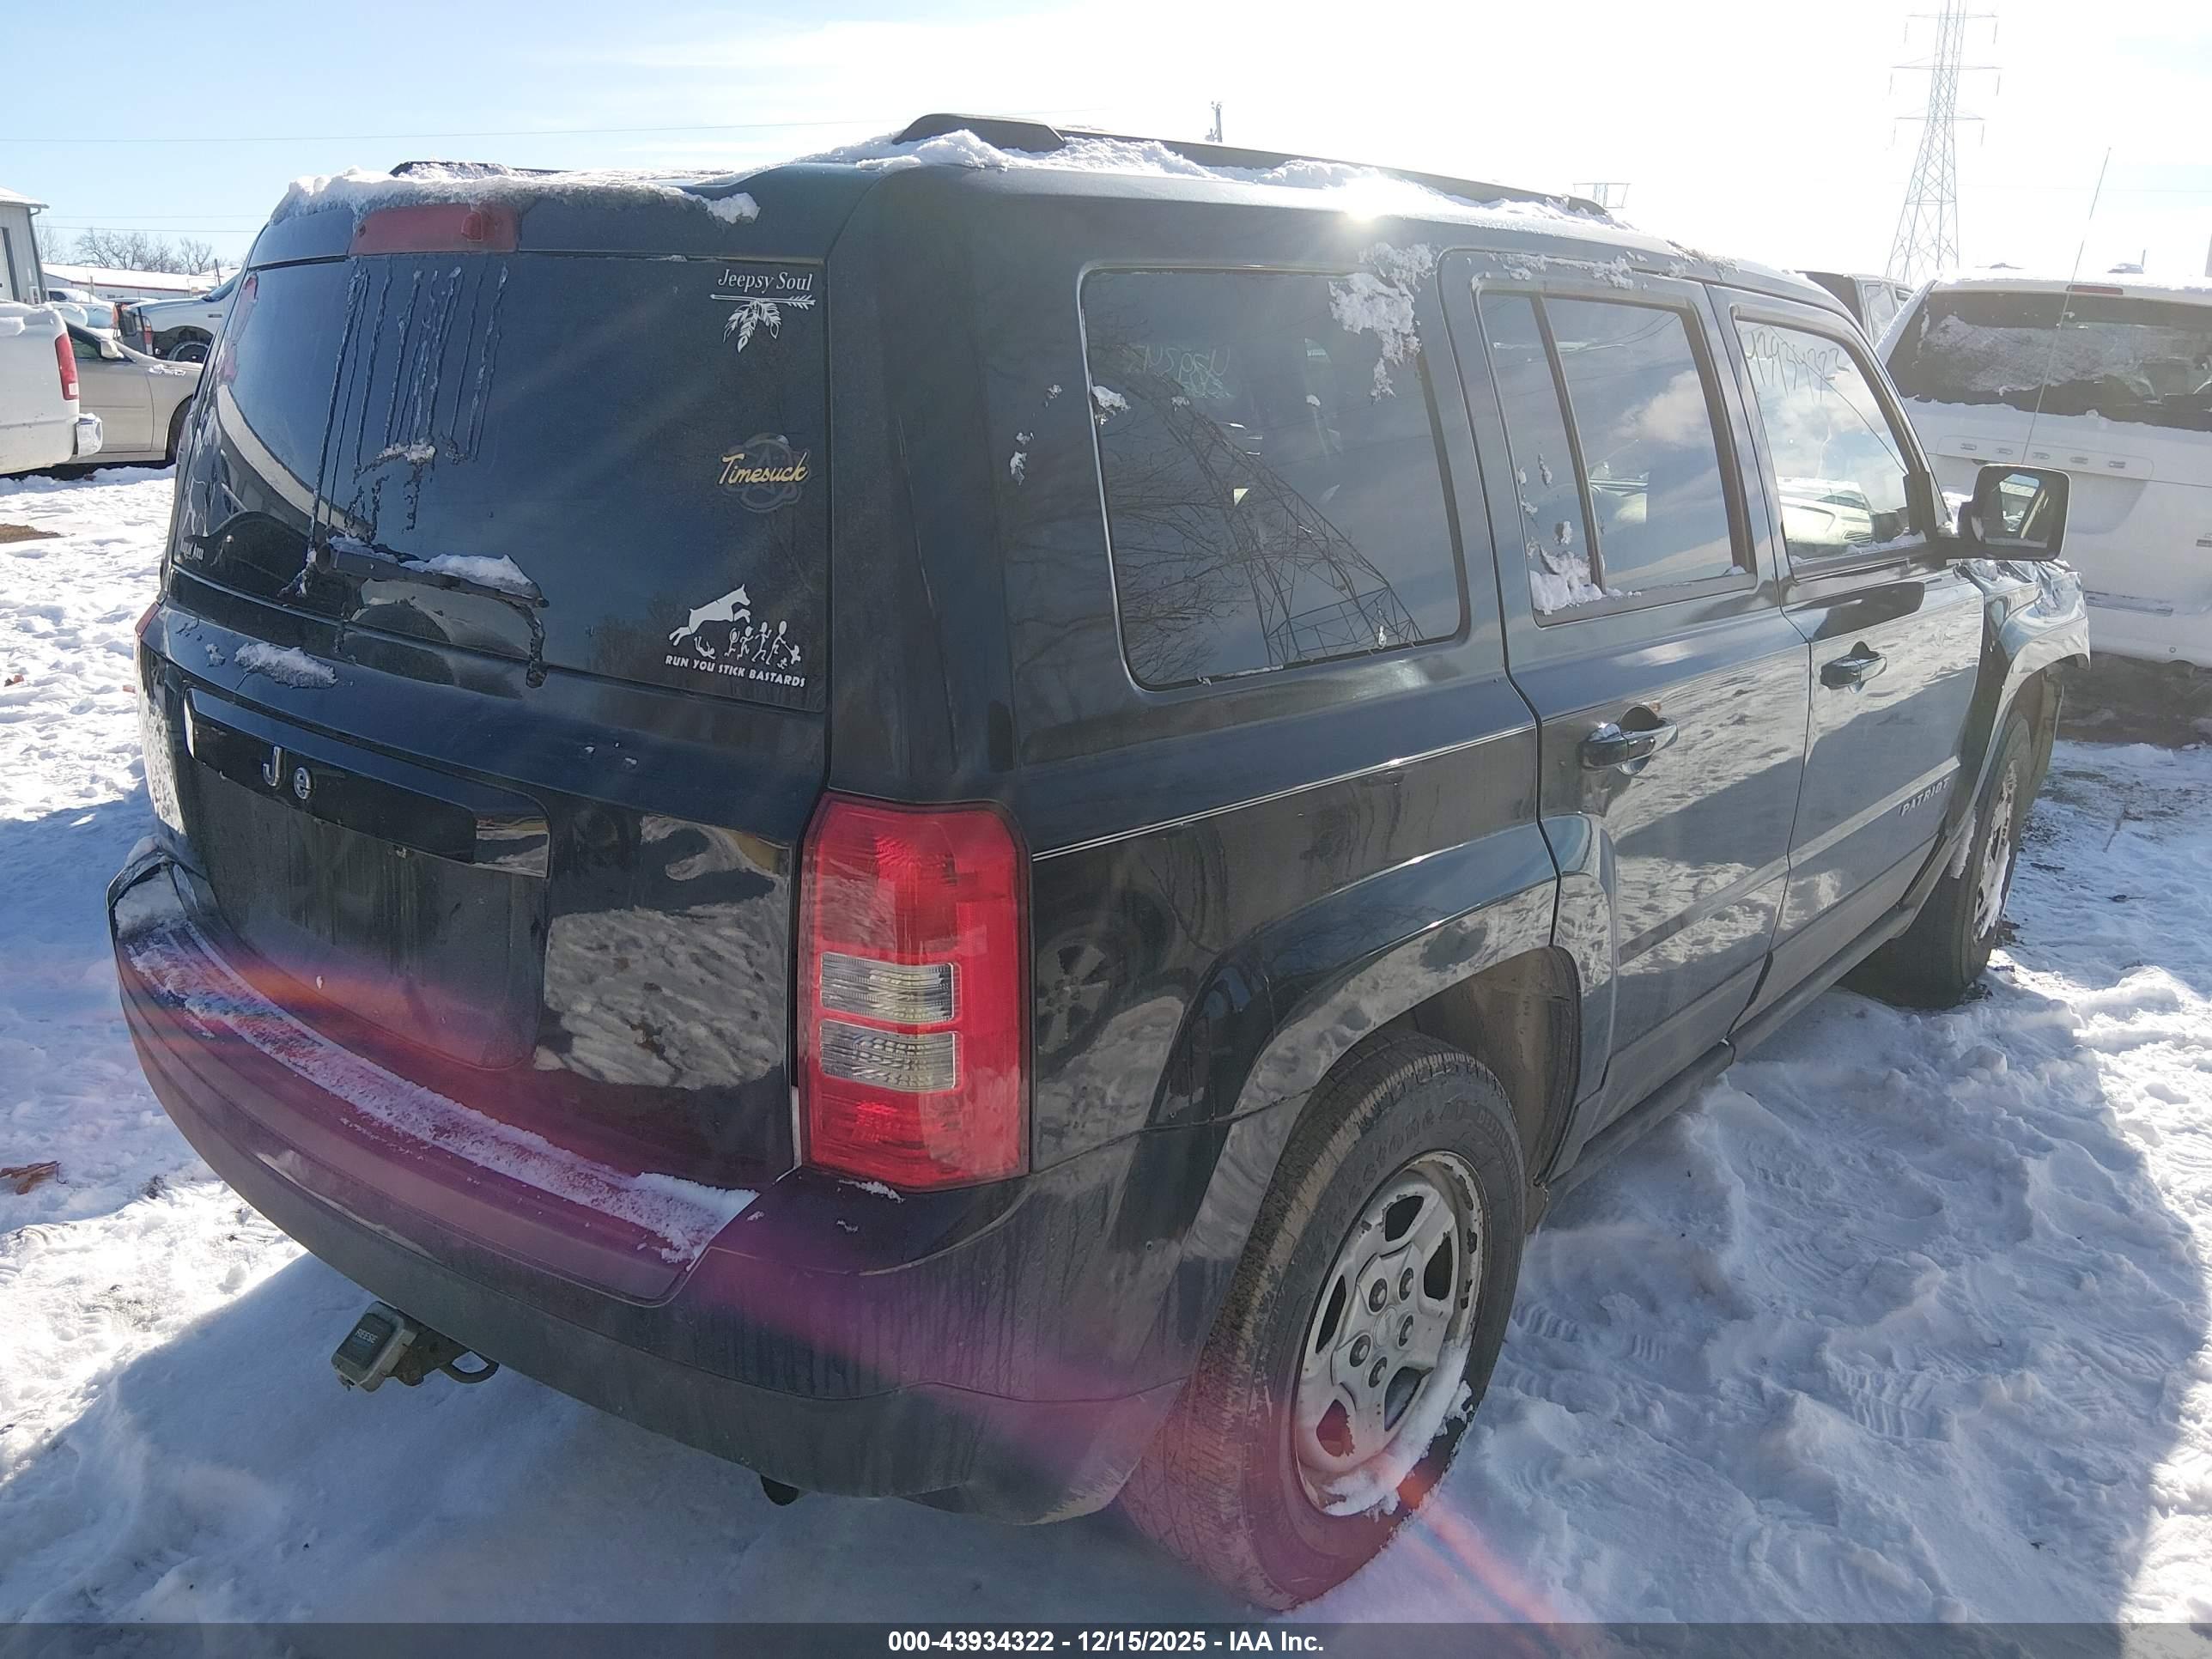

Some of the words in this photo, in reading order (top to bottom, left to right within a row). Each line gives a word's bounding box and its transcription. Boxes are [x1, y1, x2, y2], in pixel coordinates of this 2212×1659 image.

[718, 269, 774, 293] Jeepsy
[776, 271, 813, 291] Soul
[718, 452, 808, 484] Timesuck
[665, 655, 689, 668] RUN
[693, 659, 714, 672] YOU
[718, 665, 745, 678] STICK
[749, 669, 805, 687] BASTARDS
[1899, 776, 1950, 817] PATRIOT
[355, 1328, 379, 1344] REESE
